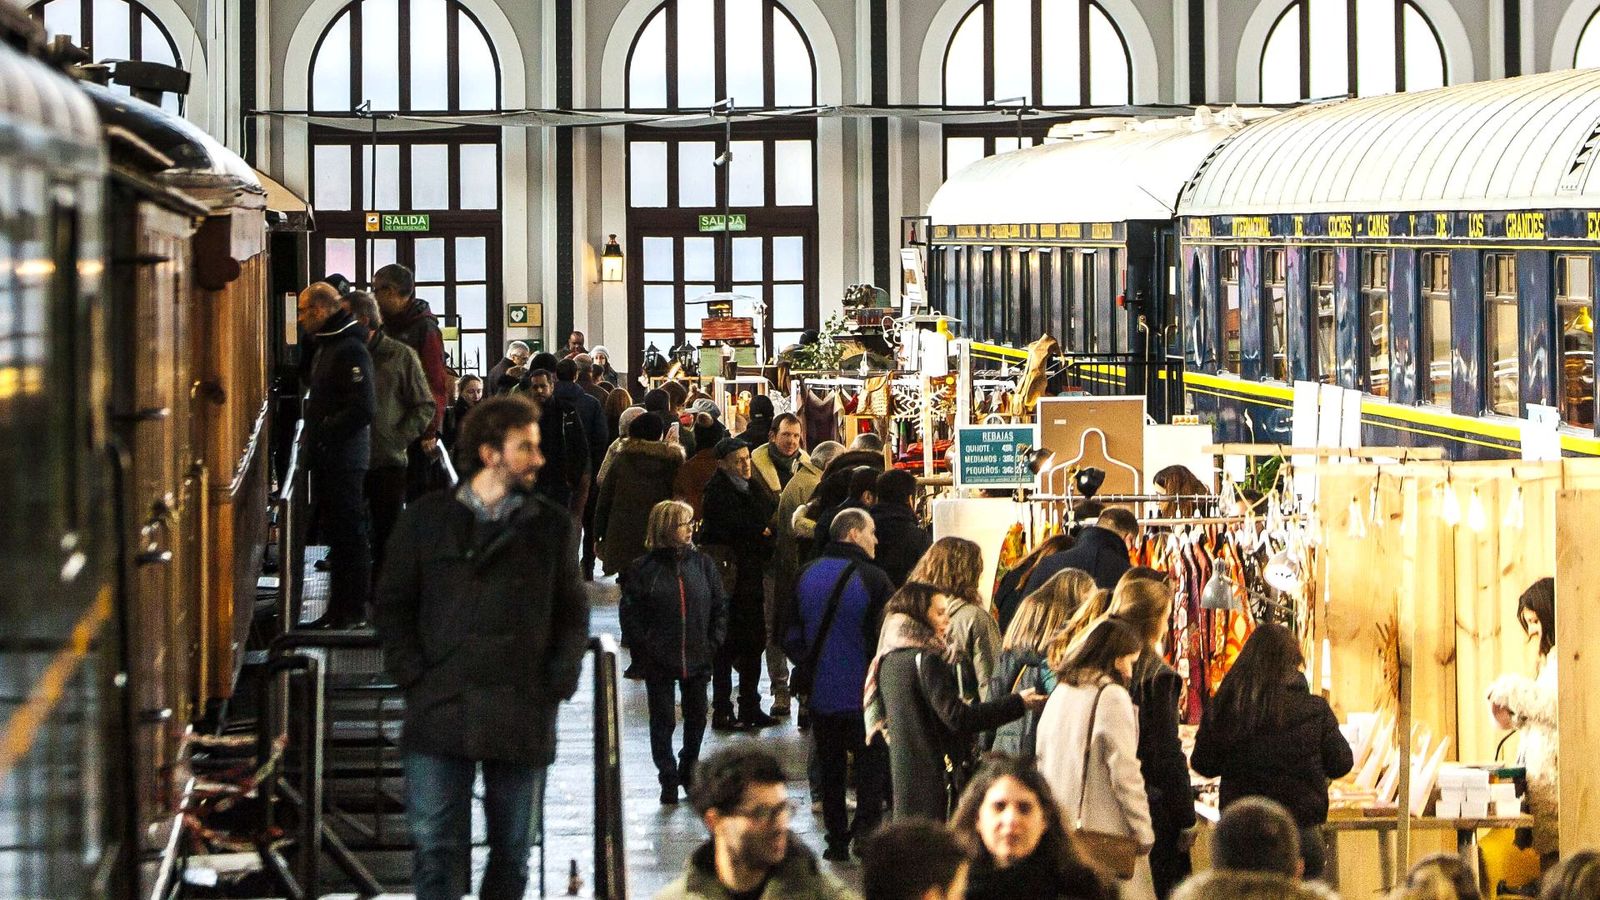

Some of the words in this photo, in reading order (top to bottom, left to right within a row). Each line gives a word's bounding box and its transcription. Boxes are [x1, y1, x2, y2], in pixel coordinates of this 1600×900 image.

[385, 216, 426, 225] SALIDA
[1328, 215, 1352, 237] COCHES
[1368, 214, 1389, 237] CAMAS
[1408, 214, 1415, 237] Y
[1436, 213, 1447, 238] DE
[1468, 213, 1484, 238] LOS
[1506, 212, 1544, 239] GRANDES
[982, 431, 1014, 441] REBAJAS
